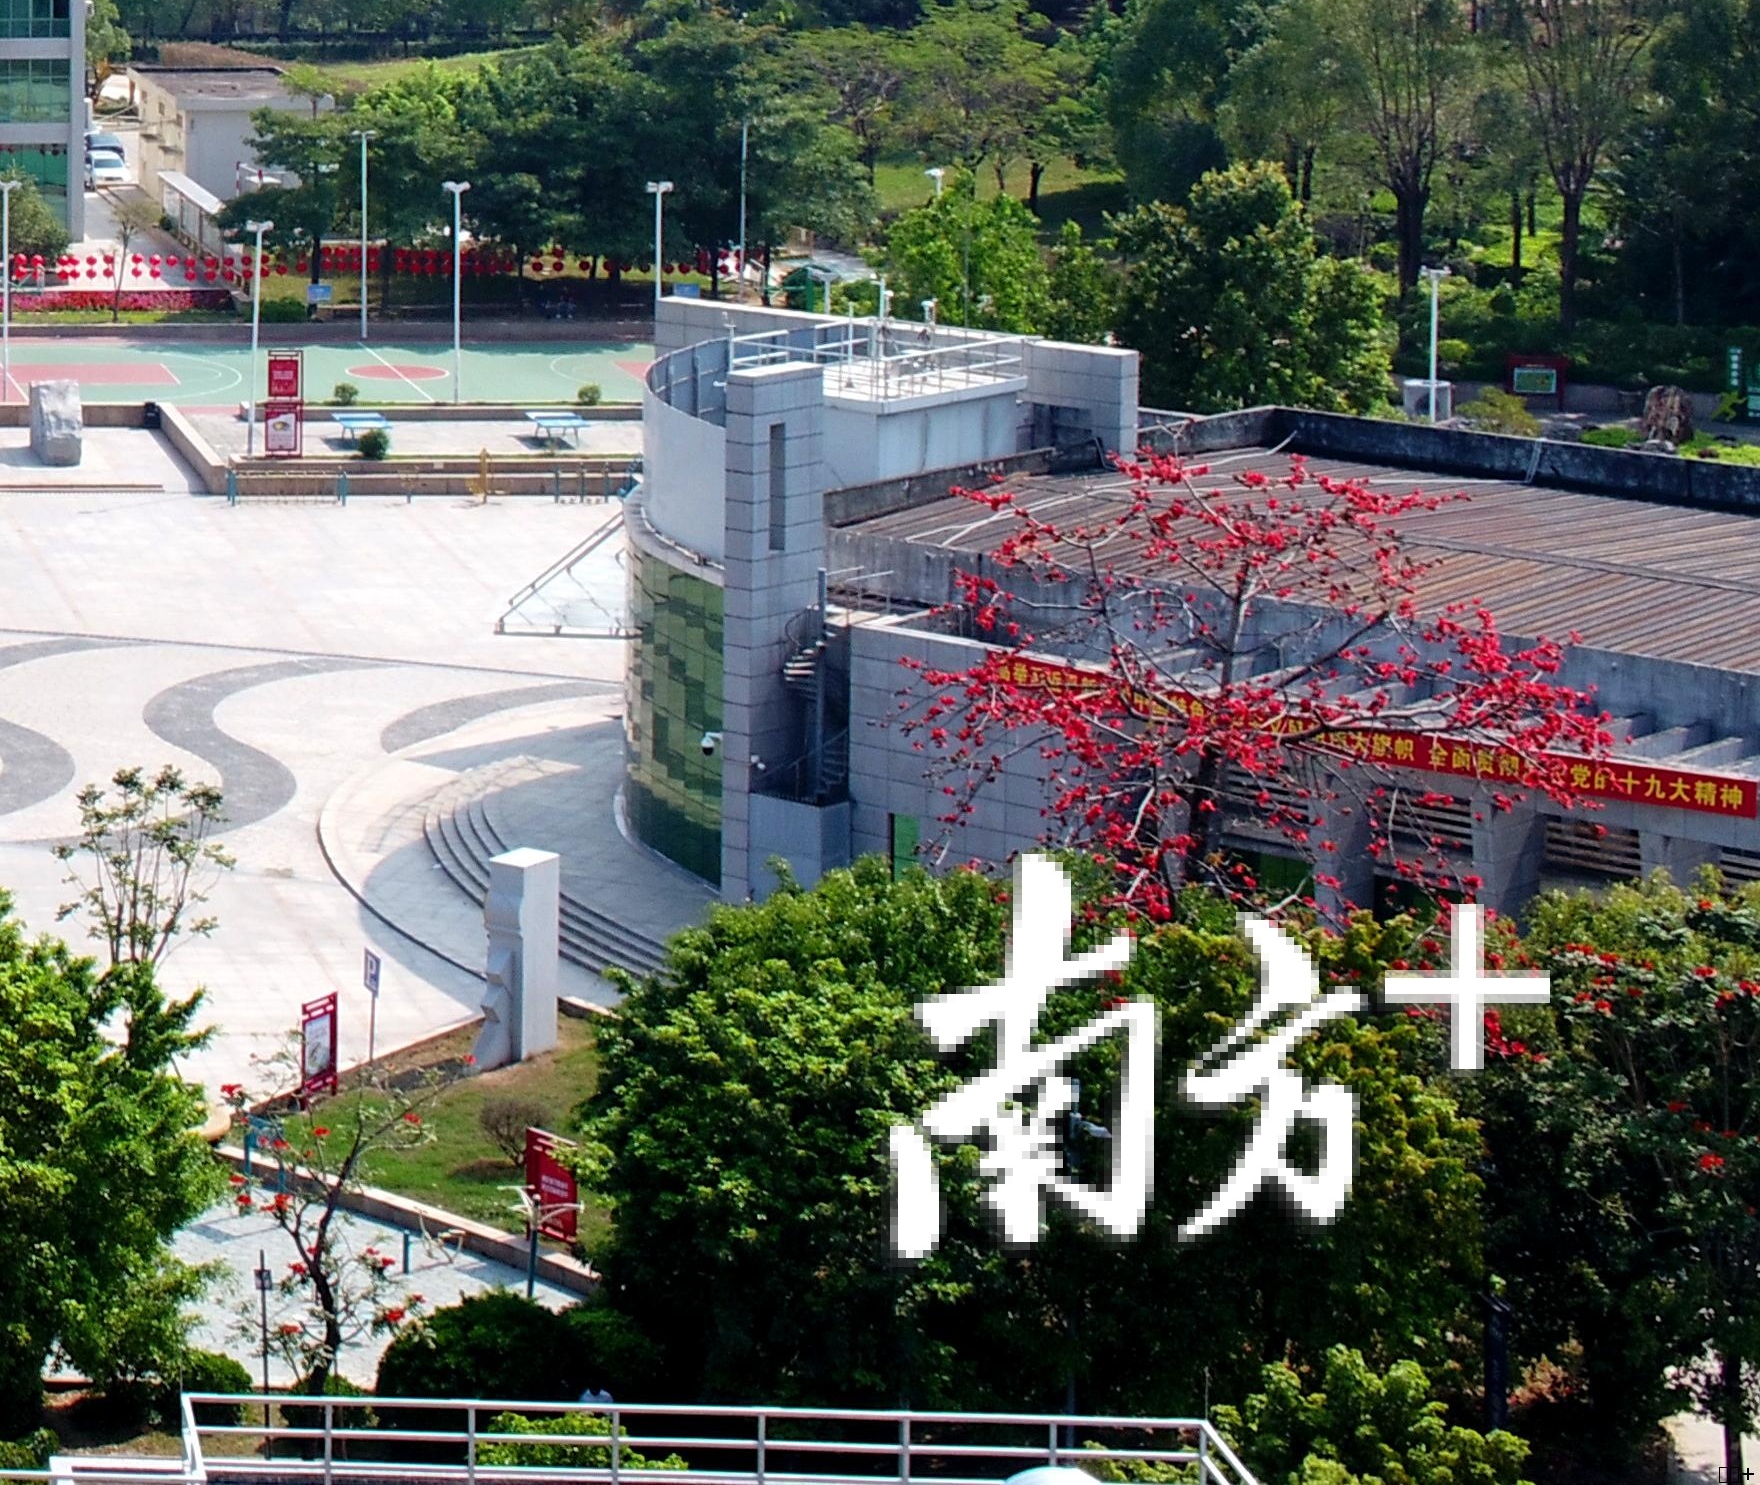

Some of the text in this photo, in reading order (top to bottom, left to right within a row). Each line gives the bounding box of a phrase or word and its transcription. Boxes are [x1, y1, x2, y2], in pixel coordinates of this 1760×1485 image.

[1428, 744, 1744, 810] 全面贯彻党的十九大精神
[367, 954, 377, 984] P
